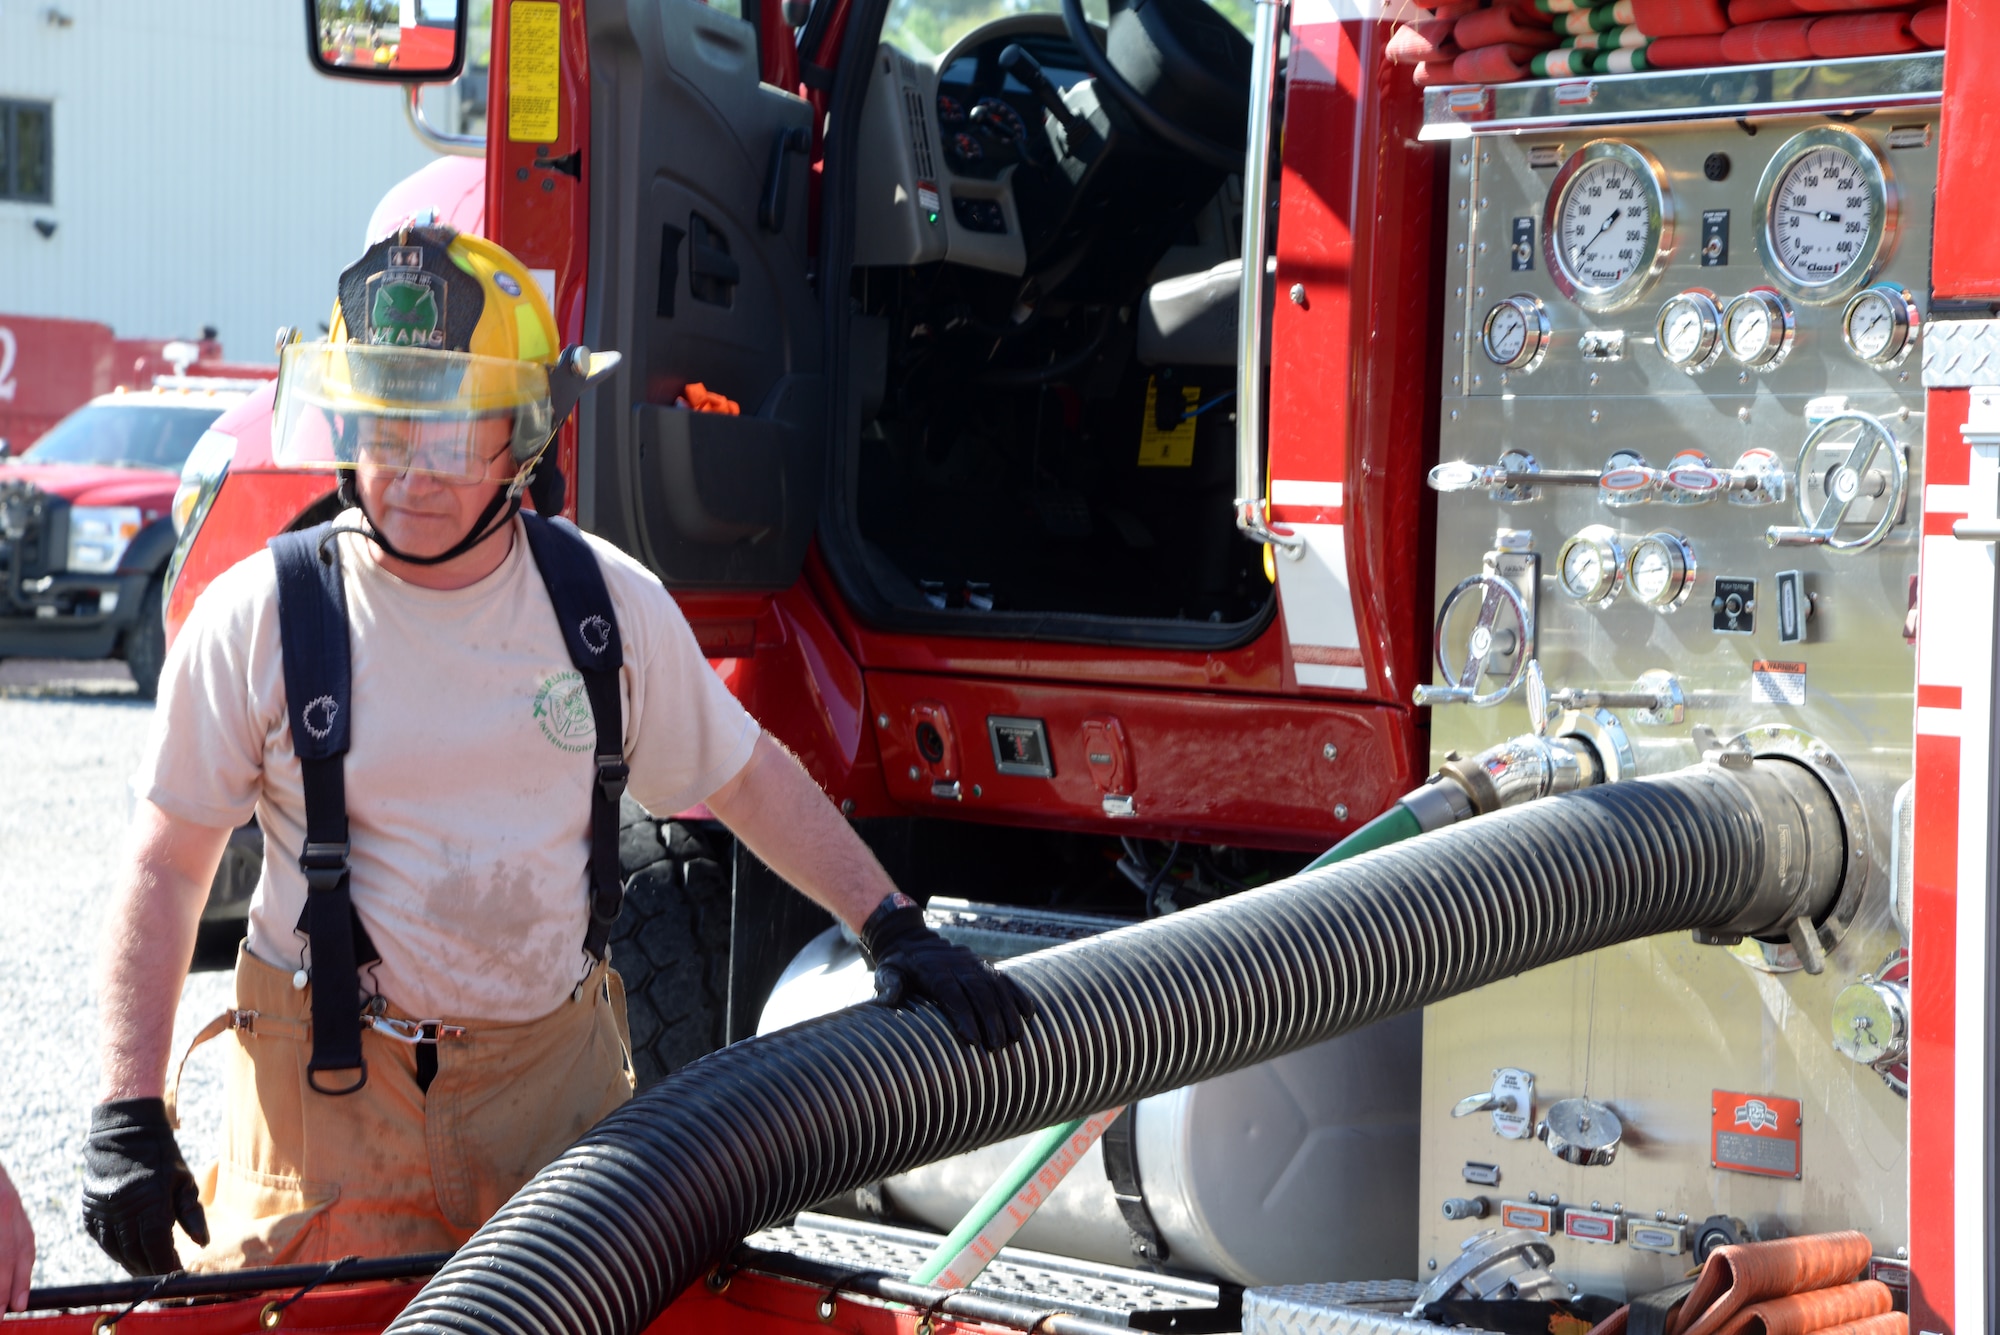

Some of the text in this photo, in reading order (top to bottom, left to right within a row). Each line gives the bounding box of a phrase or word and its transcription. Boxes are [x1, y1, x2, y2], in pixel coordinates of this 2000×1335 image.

[1824, 168, 1840, 178] 200
[1606, 178, 1621, 189] 200
[1804, 176, 1818, 187] 150
[1837, 178, 1854, 190] 250
[1588, 187, 1602, 197] 150
[1619, 188, 1634, 200] 250
[1792, 195, 1806, 206] 100
[1847, 196, 1862, 208] 300
[1578, 205, 1591, 216] 100
[1627, 206, 1642, 217] 300
[1790, 216, 1800, 227] 50
[1576, 225, 1585, 236] 50
[1845, 222, 1860, 233] 350
[1626, 230, 1640, 241] 350
[1794, 238, 1800, 249] 0
[1836, 241, 1852, 252] 400
[392, 250, 420, 266] 44
[1618, 249, 1632, 260] 400
[1766, 663, 1800, 672] WARNING
[535, 671, 582, 700] BURLING
[539, 720, 596, 752] INTERNATIONA
